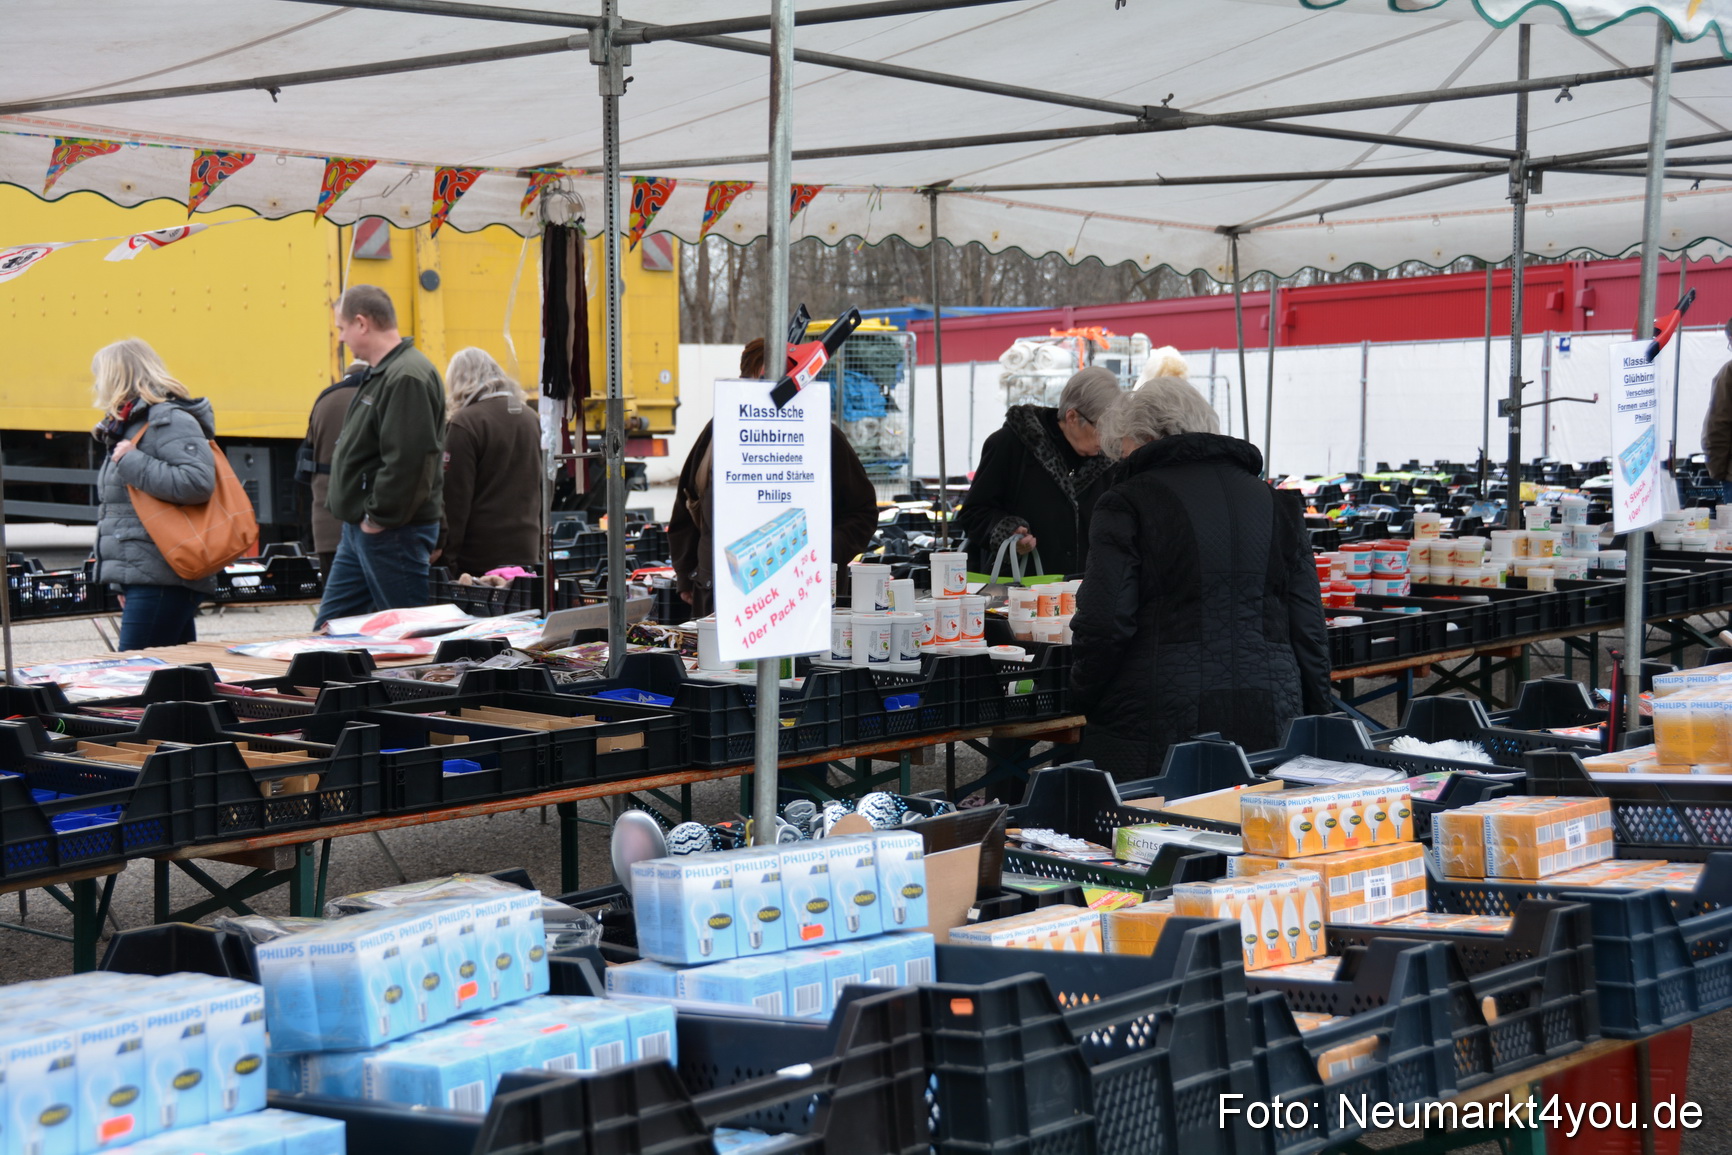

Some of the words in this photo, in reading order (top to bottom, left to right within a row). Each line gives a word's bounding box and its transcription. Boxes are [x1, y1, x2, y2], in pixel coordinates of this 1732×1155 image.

[739, 404, 804, 418] Klassische
[739, 428, 804, 443] Glühbirnen
[742, 452, 803, 463] Verschiedene
[726, 471, 763, 481] Formen
[765, 470, 784, 481] und
[786, 469, 815, 481] Stärken
[757, 489, 792, 502] Philips
[734, 614, 742, 627] 1
[744, 588, 780, 620] Stück
[809, 549, 818, 562] €
[741, 624, 769, 651] 10er
[769, 598, 797, 627] Pack
[814, 570, 823, 584] €
[1654, 675, 1684, 684] PHILIPS
[1687, 675, 1718, 683] PHILIPS
[1653, 701, 1687, 710] PHILIPS
[1690, 701, 1724, 709] PHILIPS
[1337, 792, 1361, 800] PHILIPS
[1362, 789, 1386, 797] PHILIPS
[1386, 785, 1410, 794] PHILIPS
[1312, 795, 1336, 803] PHILIPS
[830, 843, 871, 859] PHILIPS
[881, 838, 921, 849] PHILIPS
[783, 850, 825, 865] PHILIPS
[1487, 846, 1495, 875] PHILIPS
[685, 865, 730, 878] PHILIPS
[735, 859, 778, 872] PHILIPS
[475, 899, 508, 918] PHILIPS
[510, 893, 541, 911] PHILIPS
[438, 908, 472, 926] PHILIPS
[399, 919, 434, 939] PHILIPS
[360, 930, 396, 950] PHILIPS
[259, 946, 305, 961] PHILIPS
[309, 942, 356, 956] PHILIPS
[209, 992, 262, 1014] PHILIPS
[147, 1006, 203, 1029] PHILIPS
[81, 1021, 140, 1046] PHILIPS
[10, 1036, 73, 1062] PHILIPS
